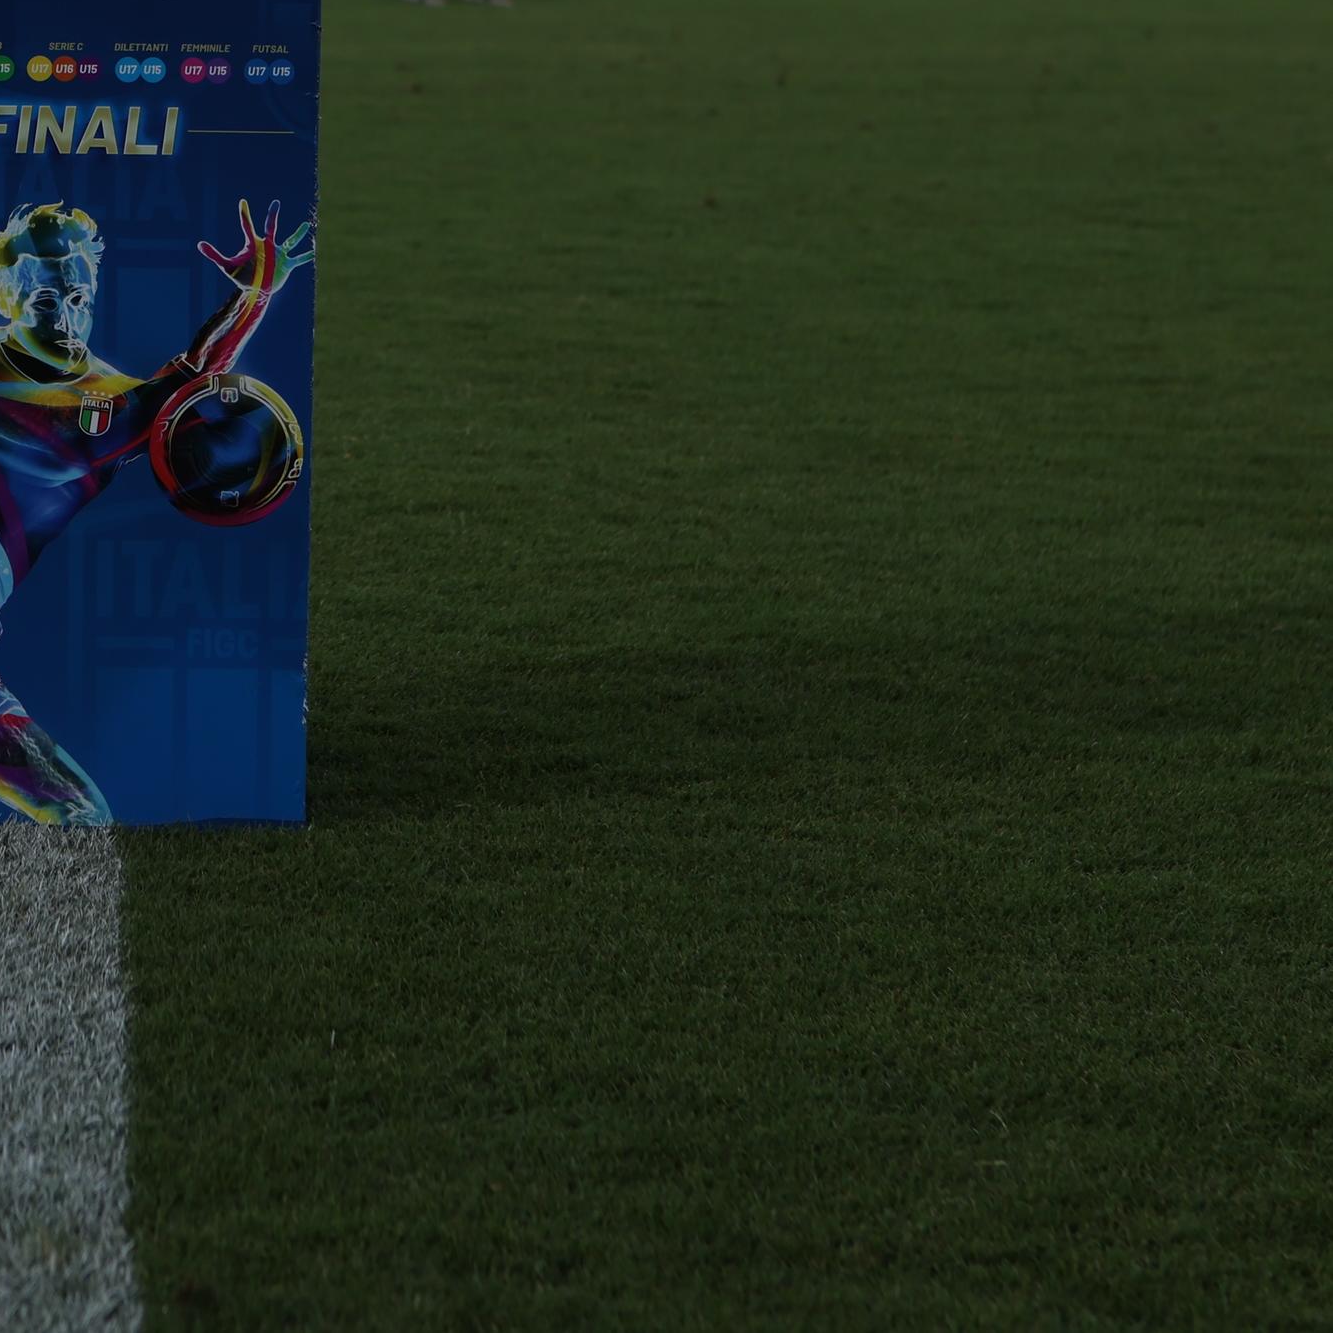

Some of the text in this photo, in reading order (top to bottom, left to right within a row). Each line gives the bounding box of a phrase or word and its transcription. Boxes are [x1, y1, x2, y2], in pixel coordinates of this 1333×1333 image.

[48, 42, 84, 51] SERIE C
[114, 43, 169, 52] DILETTANTI
[180, 44, 231, 53] FEMMINILE
[252, 45, 289, 54] FUTSAL
[31, 64, 98, 74] U17 U16 U15
[119, 64, 162, 75] U17 U15
[184, 65, 227, 76] U17 U15
[248, 66, 291, 77] U17 U15
[84, 399, 110, 409] ITALIA
[187, 628, 258, 659] FIGC
